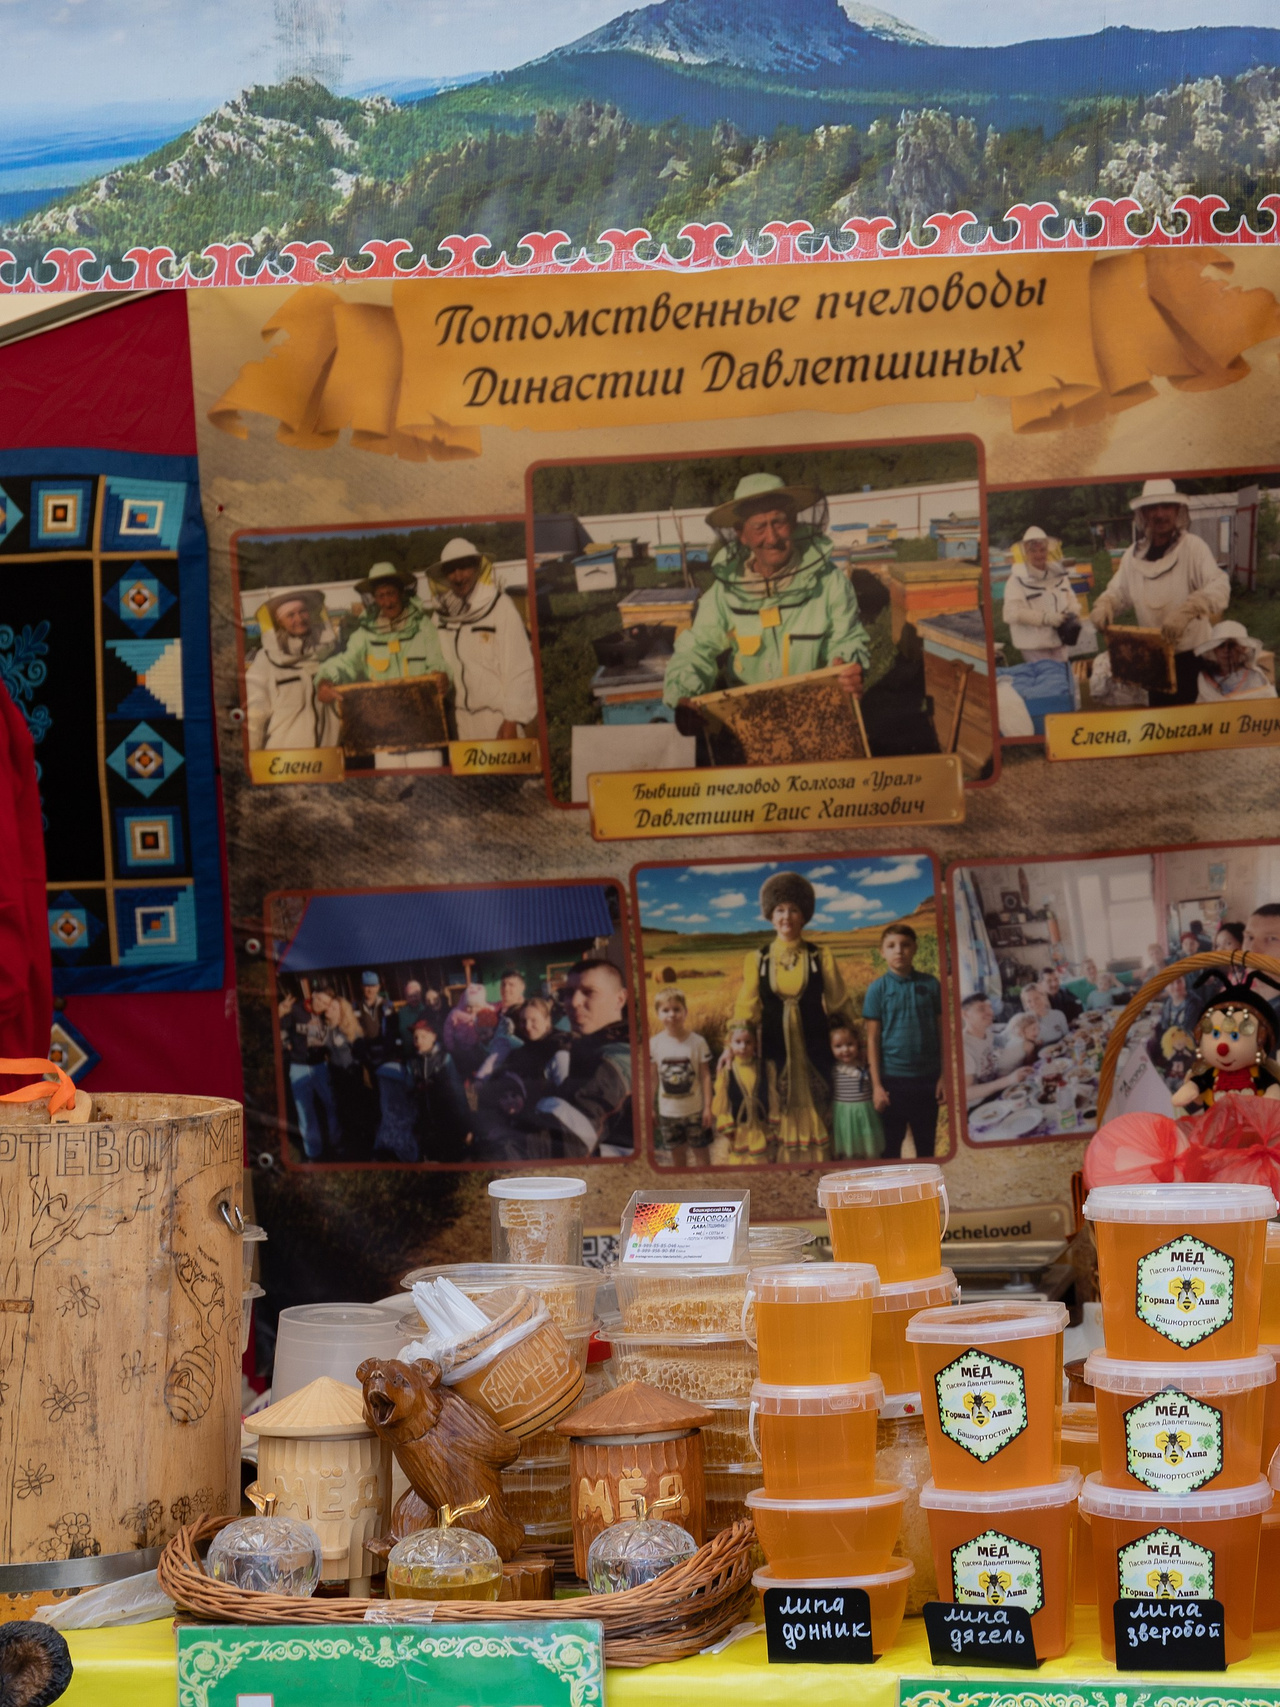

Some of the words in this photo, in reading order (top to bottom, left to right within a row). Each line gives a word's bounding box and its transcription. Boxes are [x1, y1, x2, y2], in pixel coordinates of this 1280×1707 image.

[435, 292, 799, 346] Потомственные
[814, 271, 1047, 321] пчеловоды
[463, 361, 685, 408] Династии
[701, 340, 1025, 393] Давлетшиных
[1071, 727, 1131, 746] Елена,
[1139, 722, 1213, 742] Адыгам
[1219, 721, 1230, 735] и
[463, 748, 532, 768] Адыгам
[268, 757, 323, 776] Елена
[633, 782, 701, 800] Бывший
[706, 776, 780, 797] пчеловод
[786, 775, 855, 792] Колхоза
[862, 770, 922, 792] «Урал»
[633, 807, 755, 829] Давлетшин
[761, 802, 811, 823] Раис
[818, 796, 925, 819] Хапизович
[1170, 1249, 1205, 1265] МЁД
[1149, 1266, 1175, 1275] Пасека
[1176, 1265, 1226, 1276] Давлетшиных
[1144, 1295, 1175, 1305] Горная
[1155, 1314, 1216, 1327] Башкортостан
[961, 1364, 993, 1379] МЁД
[946, 1381, 966, 1390] Пасека
[967, 1379, 1015, 1388] Давлетшиных
[945, 1410, 971, 1419] Горная
[991, 1409, 1012, 1418] Липа
[1155, 1402, 1190, 1418] МЁД
[1136, 1420, 1160, 1430] Пасека
[1161, 1419, 1213, 1428] Давлетшиных
[957, 1426, 1011, 1442] Башкортостан
[1132, 1449, 1162, 1459] Горная
[1185, 1450, 1208, 1458] Липа
[1144, 1468, 1205, 1481] Башкортостан
[977, 1544, 1010, 1559] МЁД
[1147, 1542, 1181, 1557] МЁД
[962, 1560, 982, 1568] Пасека
[983, 1559, 1032, 1567] Давлетшиных
[1128, 1558, 1152, 1568] Пасека
[1153, 1558, 1204, 1567] Давлетшиных
[960, 1587, 985, 1598] Горная
[1006, 1588, 1028, 1597] Липа
[1125, 1587, 1154, 1597] Горная
[1177, 1589, 1199, 1597] Липа
[779, 1595, 844, 1615] липа
[1129, 1602, 1202, 1618] липа
[943, 1608, 1010, 1624] липа
[782, 1621, 871, 1650] донник
[950, 1628, 1026, 1653] дягель
[1127, 1619, 1221, 1647] зверобой
